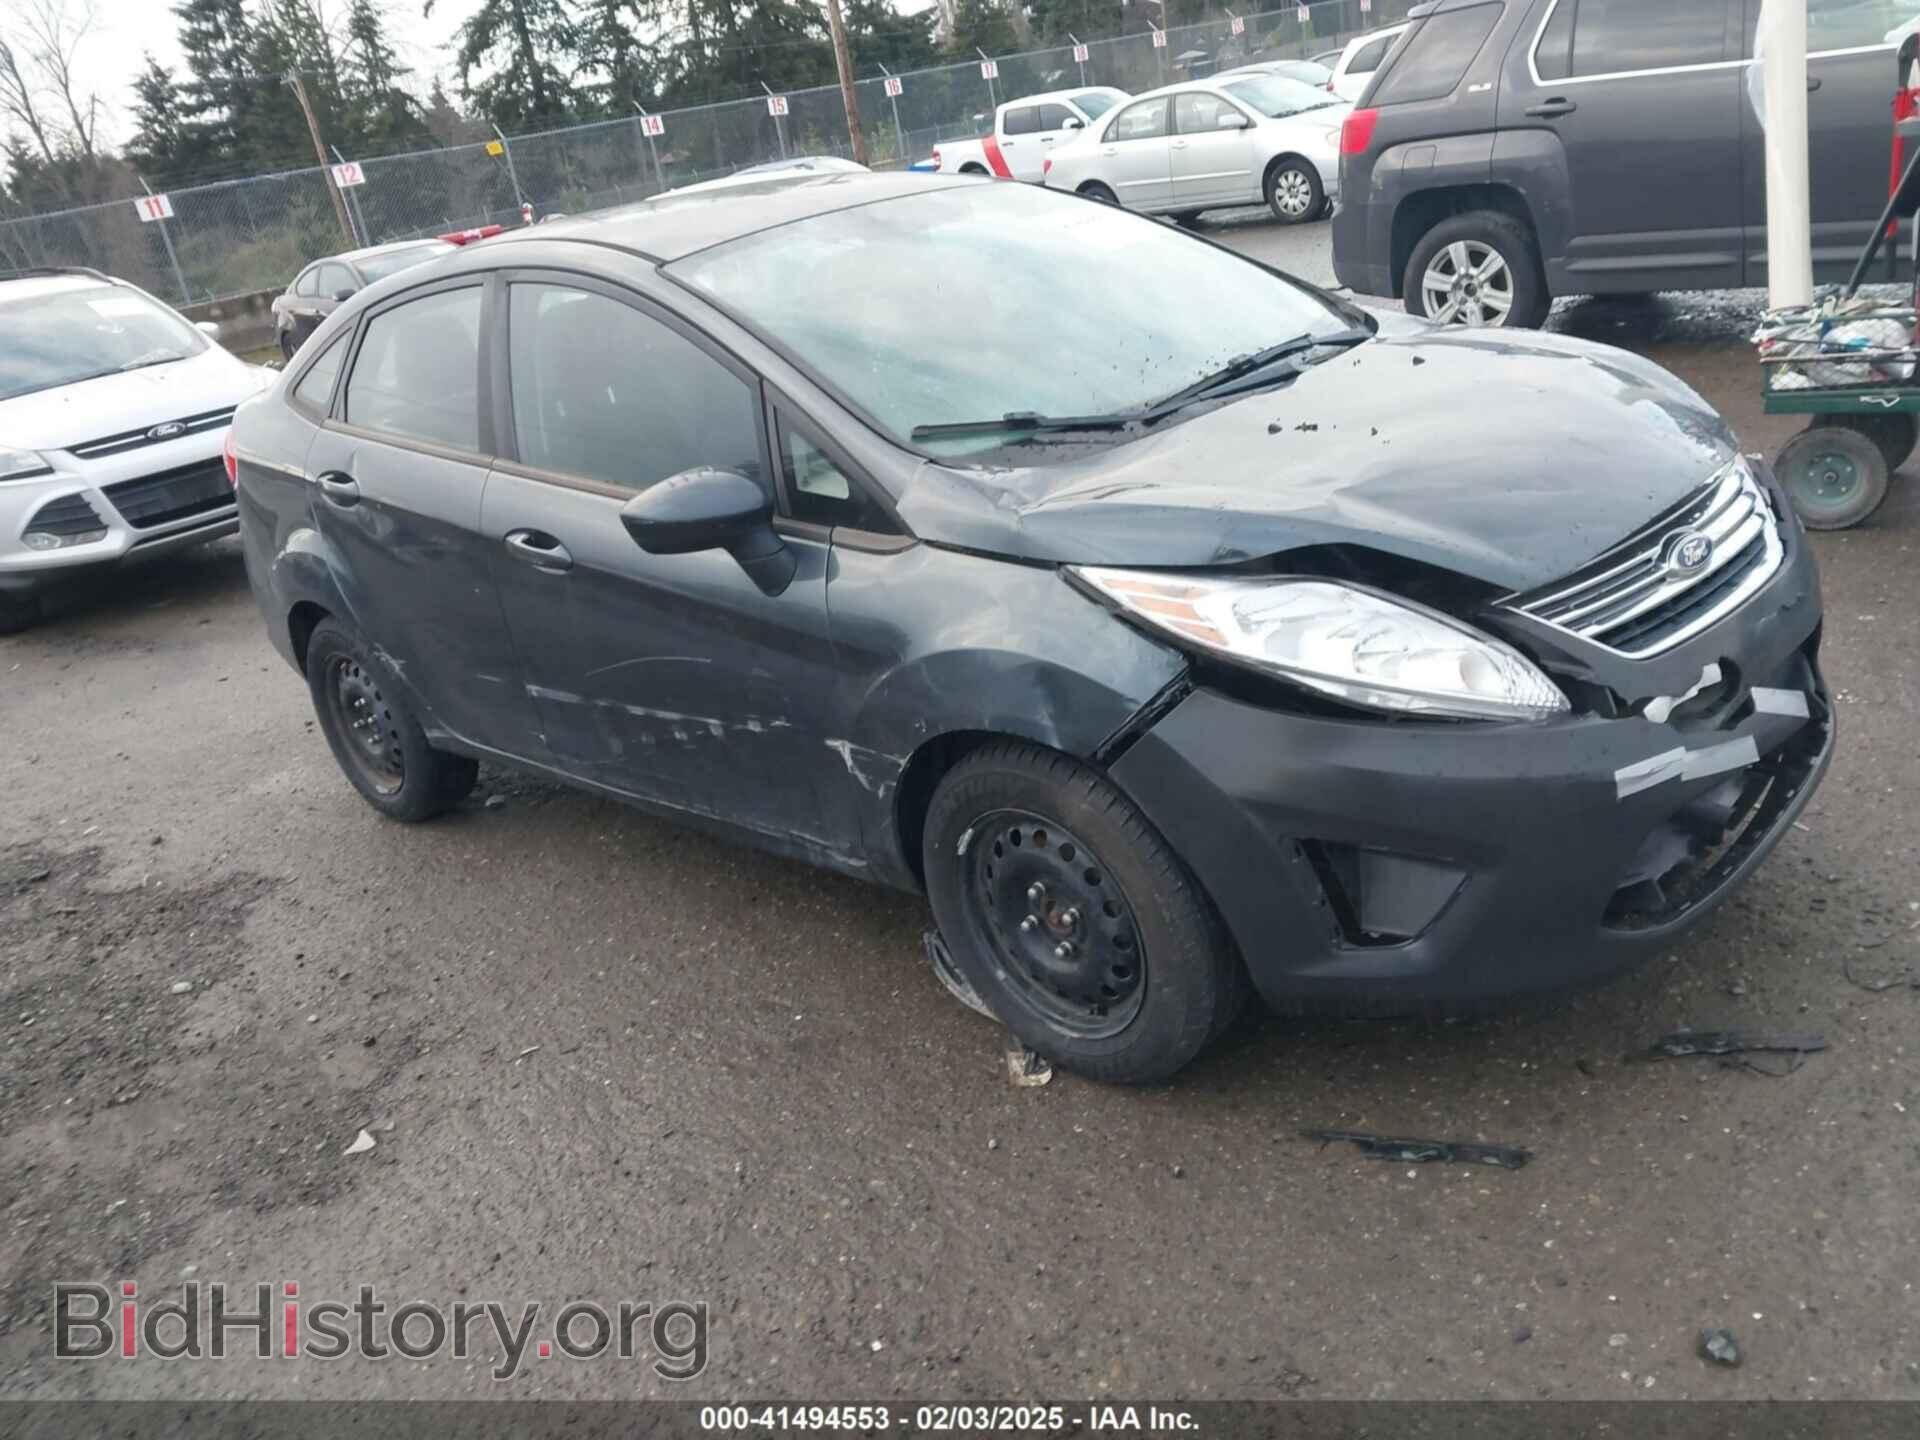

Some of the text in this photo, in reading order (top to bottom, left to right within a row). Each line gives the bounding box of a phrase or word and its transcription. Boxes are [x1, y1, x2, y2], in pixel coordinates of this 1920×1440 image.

[887, 79, 900, 95] 16
[771, 96, 785, 114] 15
[645, 115, 660, 135] 14
[336, 165, 361, 184] 12
[144, 198, 165, 218] 11
